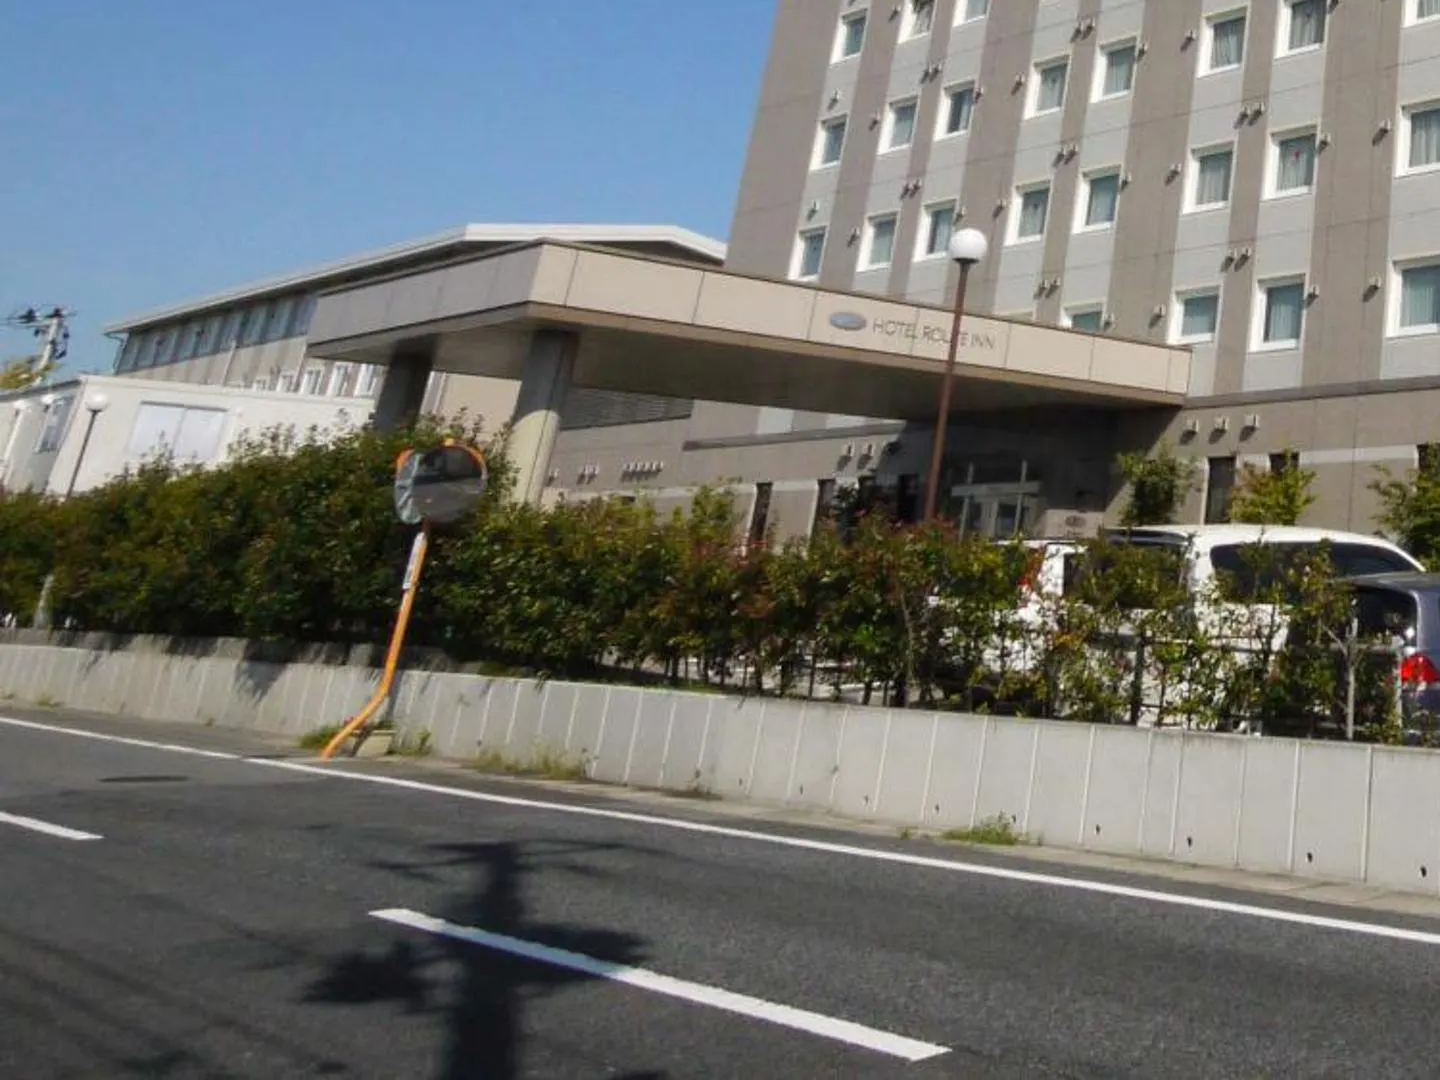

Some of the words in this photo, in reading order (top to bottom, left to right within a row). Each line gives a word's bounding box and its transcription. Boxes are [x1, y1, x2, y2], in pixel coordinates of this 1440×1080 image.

[873, 318, 918, 340] HOTEL
[922, 325, 969, 347] ROUE
[970, 332, 995, 350] INN
